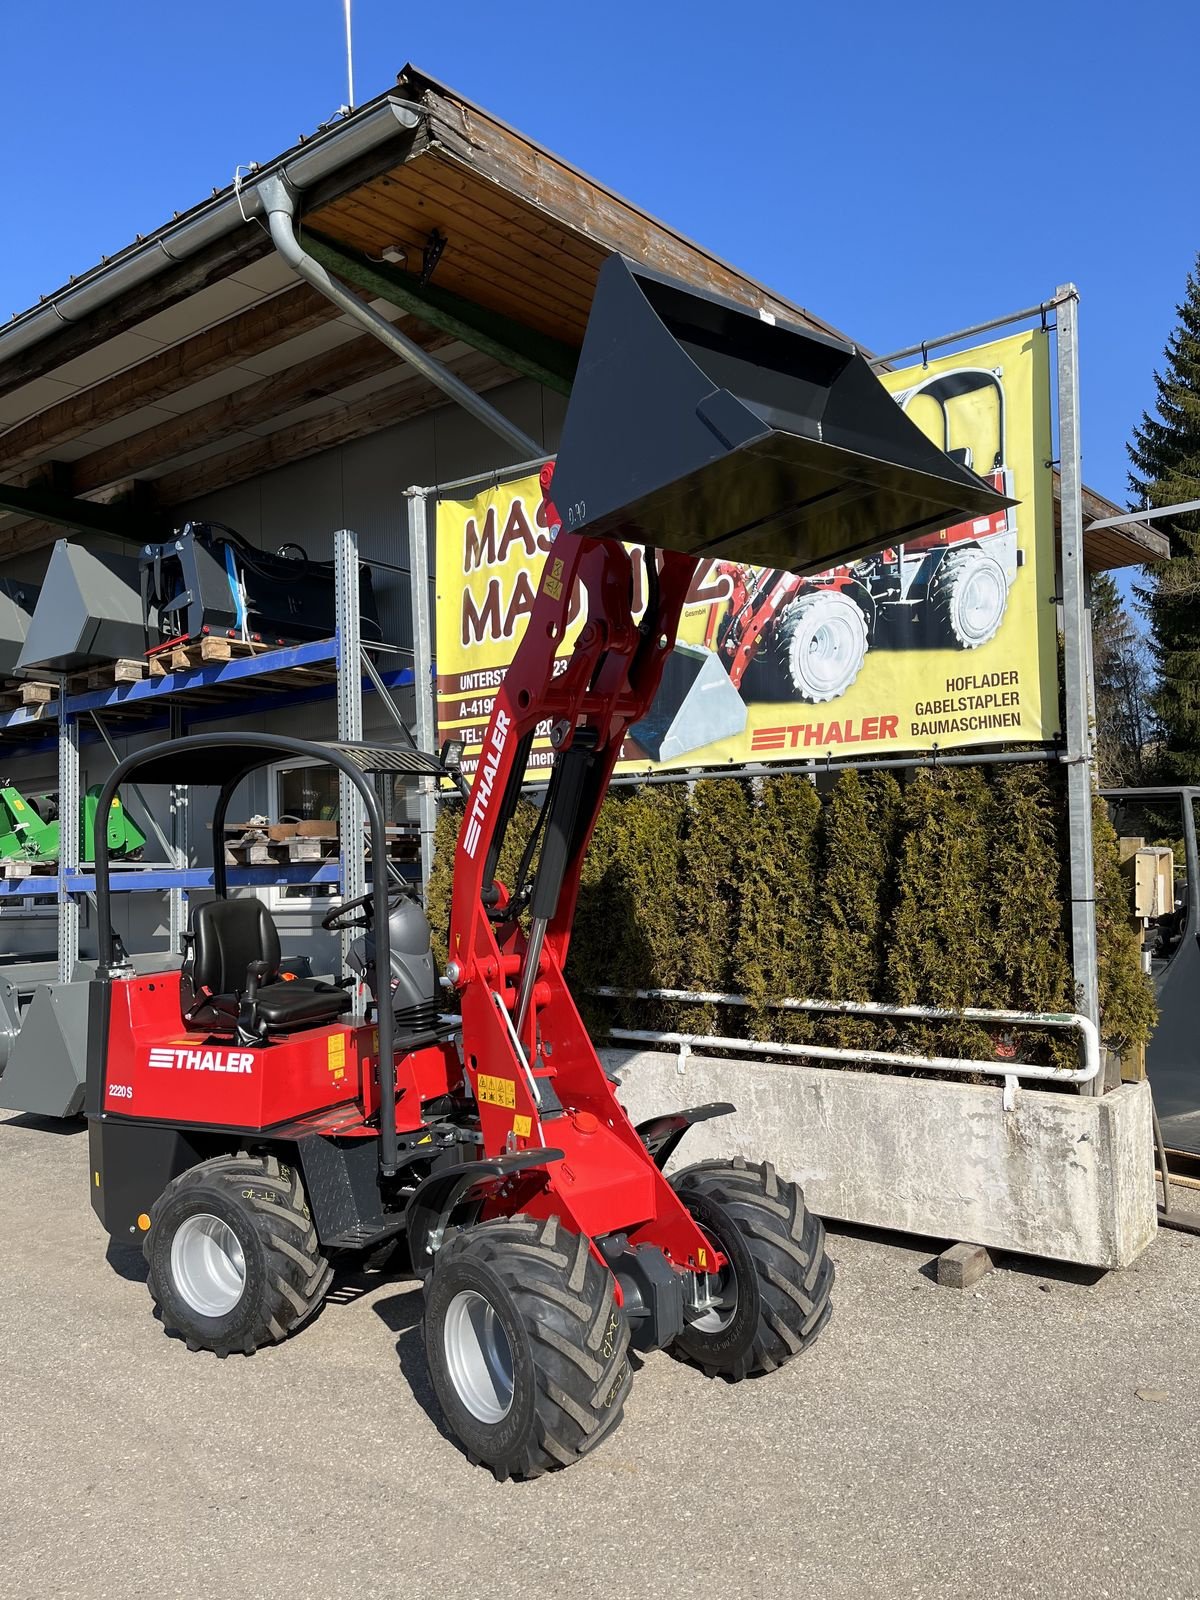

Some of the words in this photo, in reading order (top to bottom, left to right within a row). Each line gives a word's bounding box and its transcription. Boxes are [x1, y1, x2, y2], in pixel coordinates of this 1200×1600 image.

[460, 667, 510, 690] UNTERST
[946, 670, 1019, 692] HOFLADER
[915, 691, 1020, 716] GABELSTAPLER
[911, 712, 1021, 736] BAUMASCHINEN
[460, 728, 482, 744] TEL:
[108, 1084, 127, 1098] 2220
[126, 1086, 133, 1099] S
